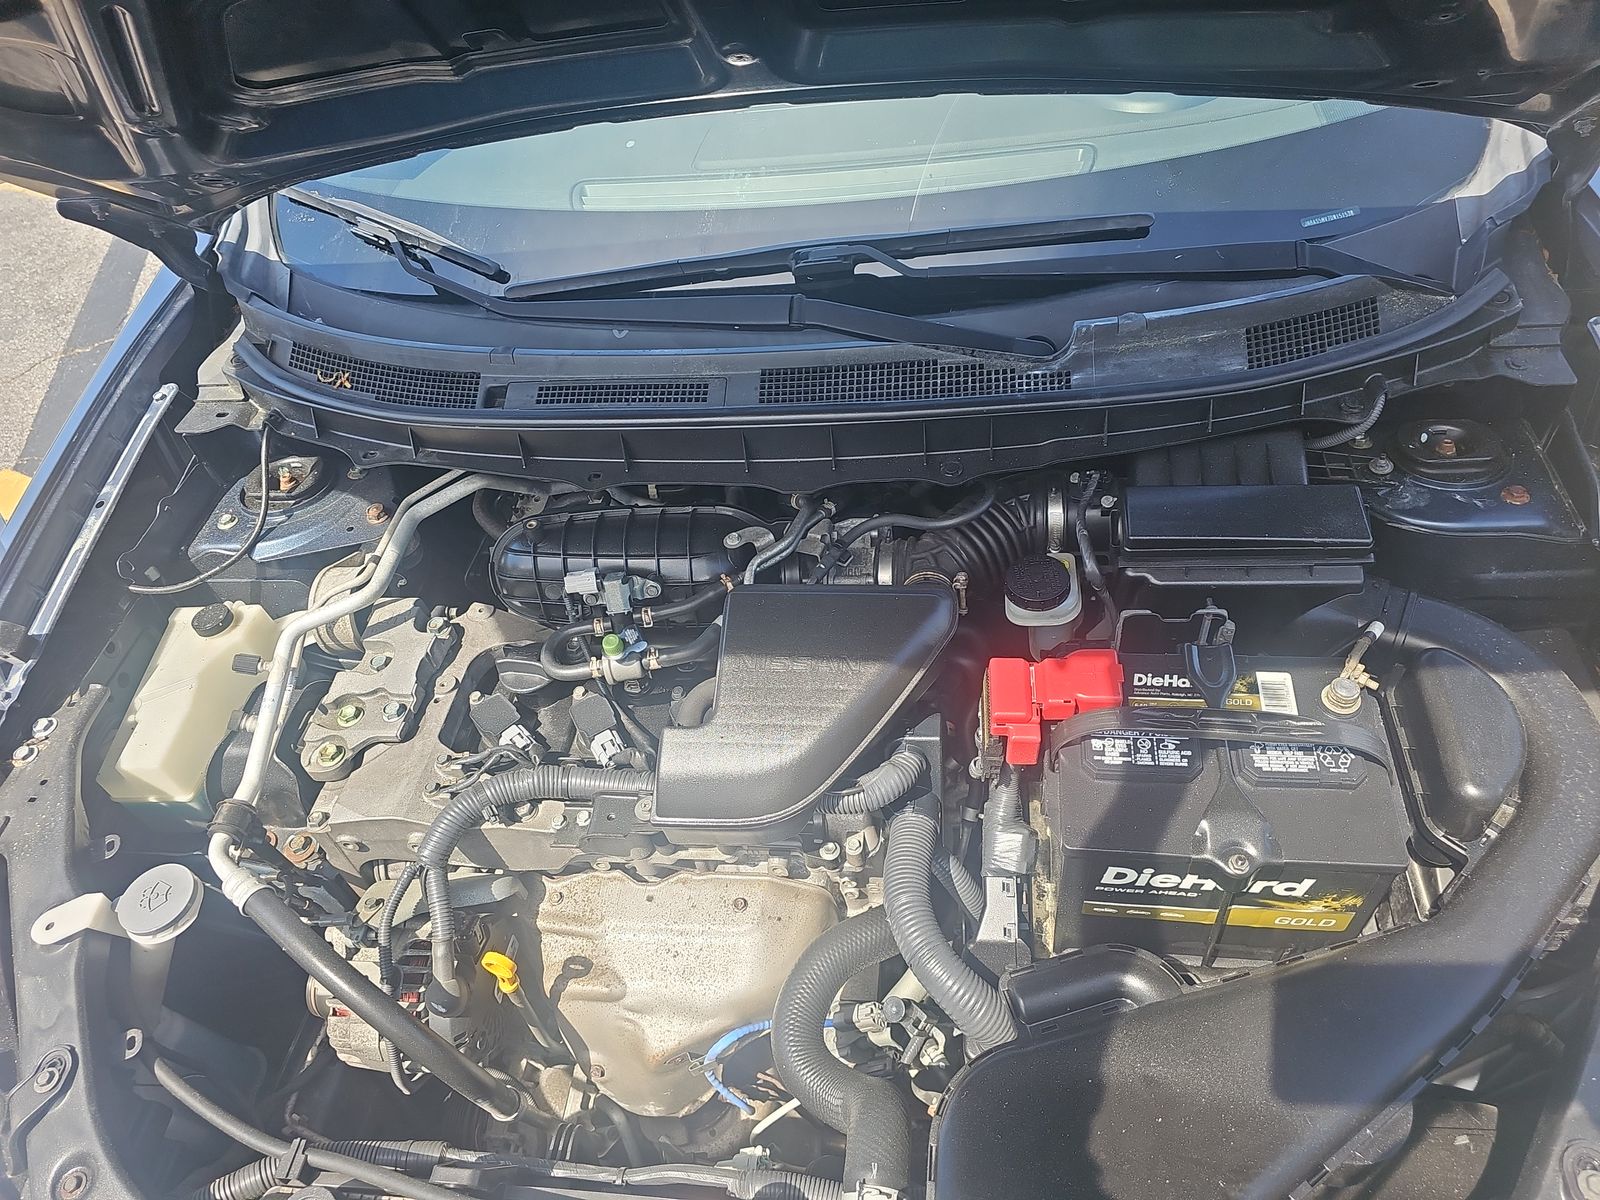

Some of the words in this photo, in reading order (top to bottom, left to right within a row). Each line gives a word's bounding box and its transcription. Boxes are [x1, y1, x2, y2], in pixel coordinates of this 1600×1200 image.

[732, 654, 863, 673] NISSAN
[1133, 673, 1193, 688] DieHa
[1225, 698, 1253, 706] GOLD
[1100, 866, 1316, 897] DieHrd
[1148, 890, 1200, 898] AHEAD
[1274, 916, 1336, 927] GOLD
